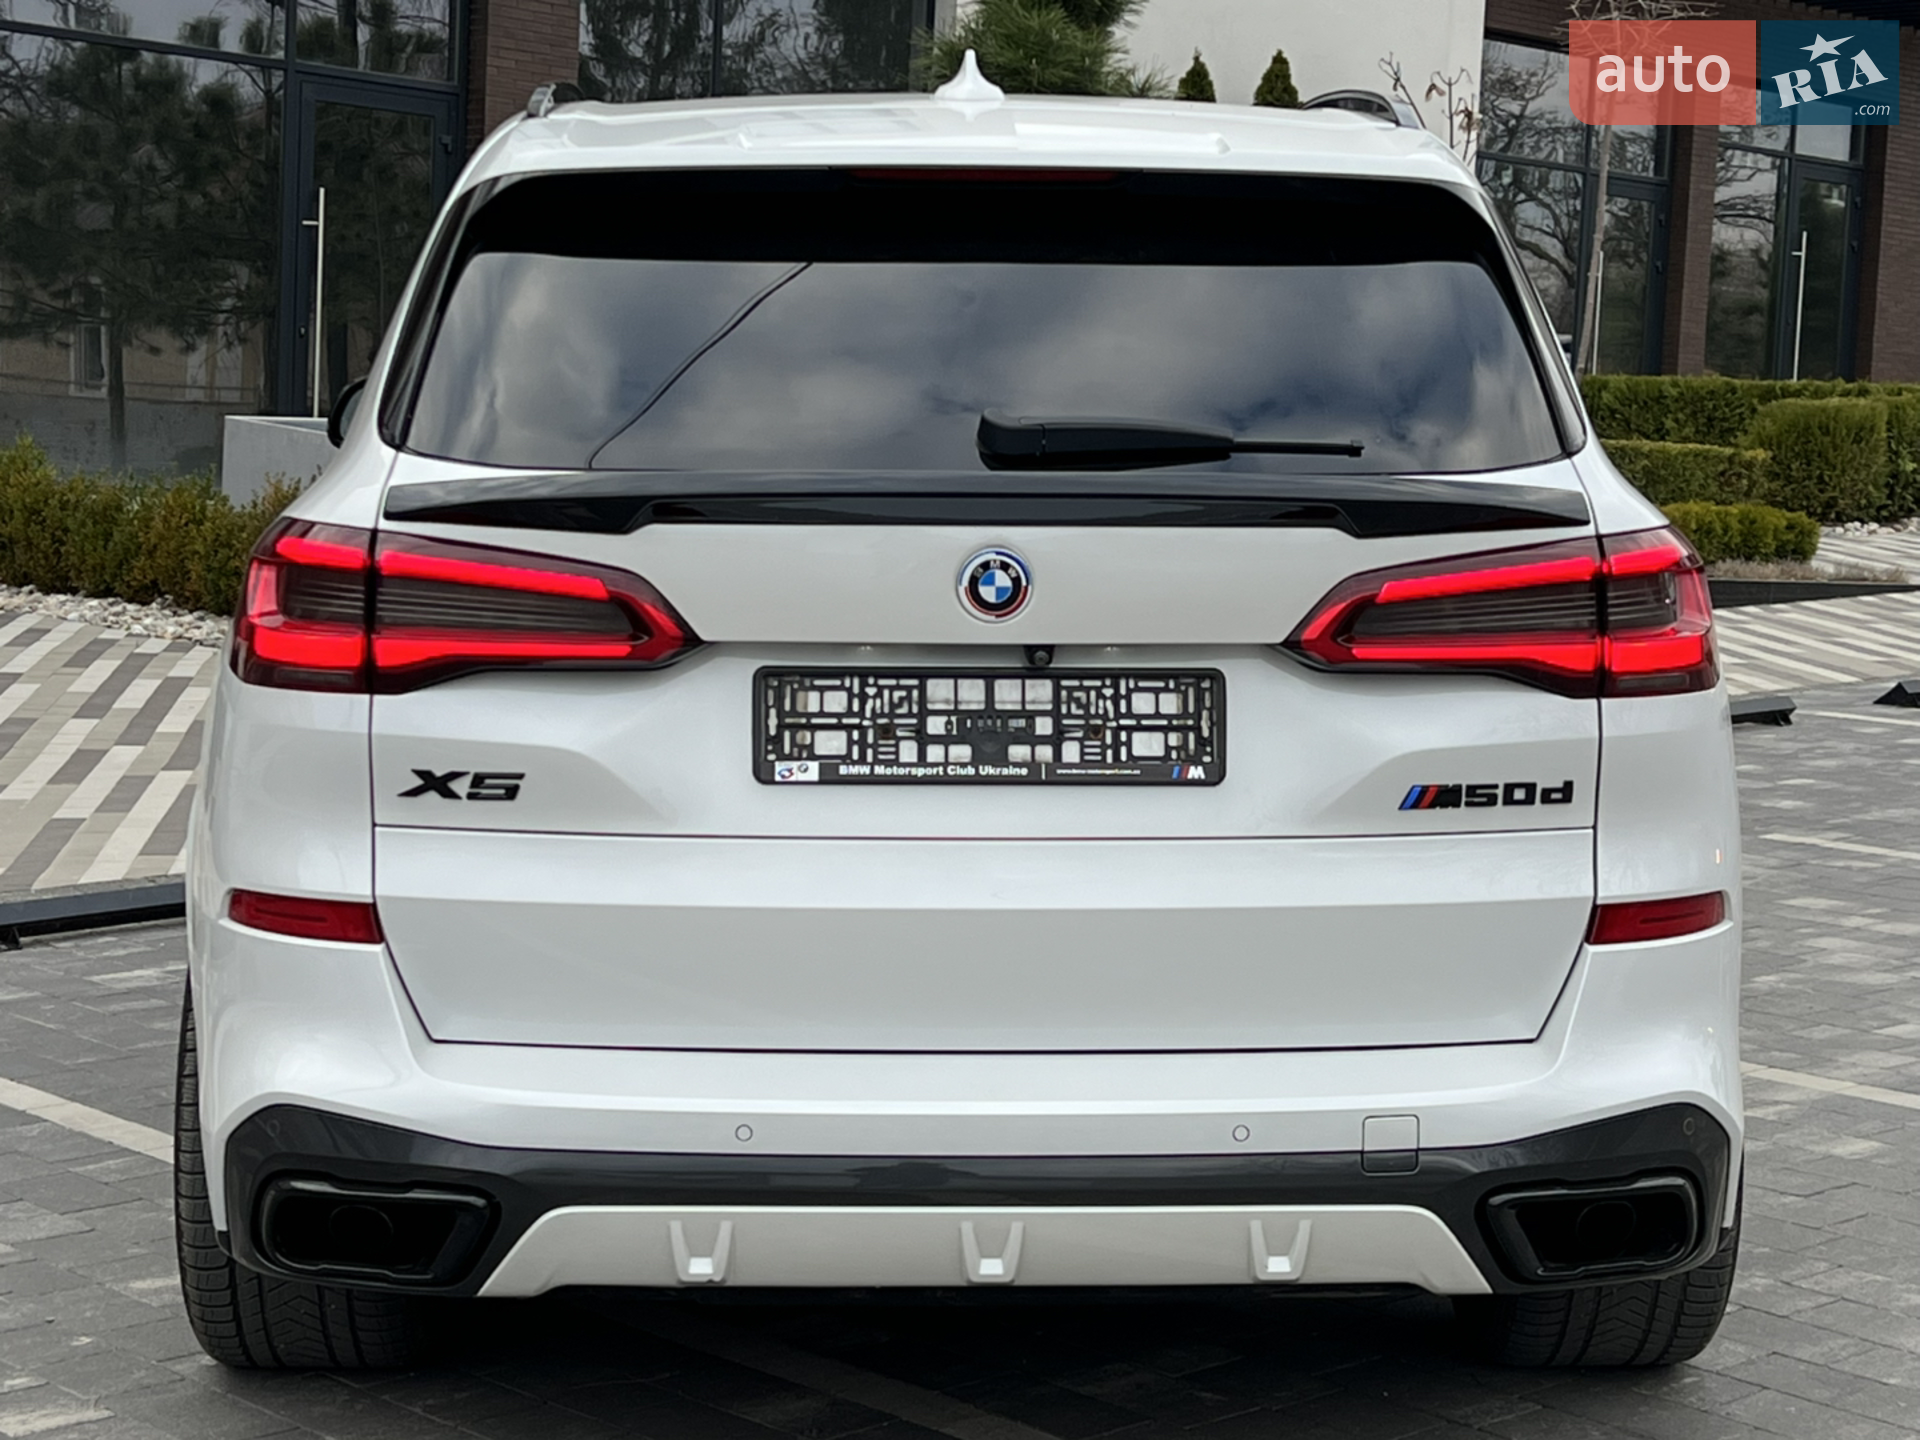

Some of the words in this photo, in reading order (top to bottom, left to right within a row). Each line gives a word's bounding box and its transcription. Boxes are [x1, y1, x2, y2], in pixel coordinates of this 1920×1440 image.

[973, 559, 1018, 578] BMW
[838, 764, 871, 776] BMW
[873, 764, 944, 778] Motorsport
[946, 764, 976, 776] Club
[978, 764, 1029, 776] Ukraine
[396, 768, 526, 801] X5
[1430, 780, 1574, 809] M50d
